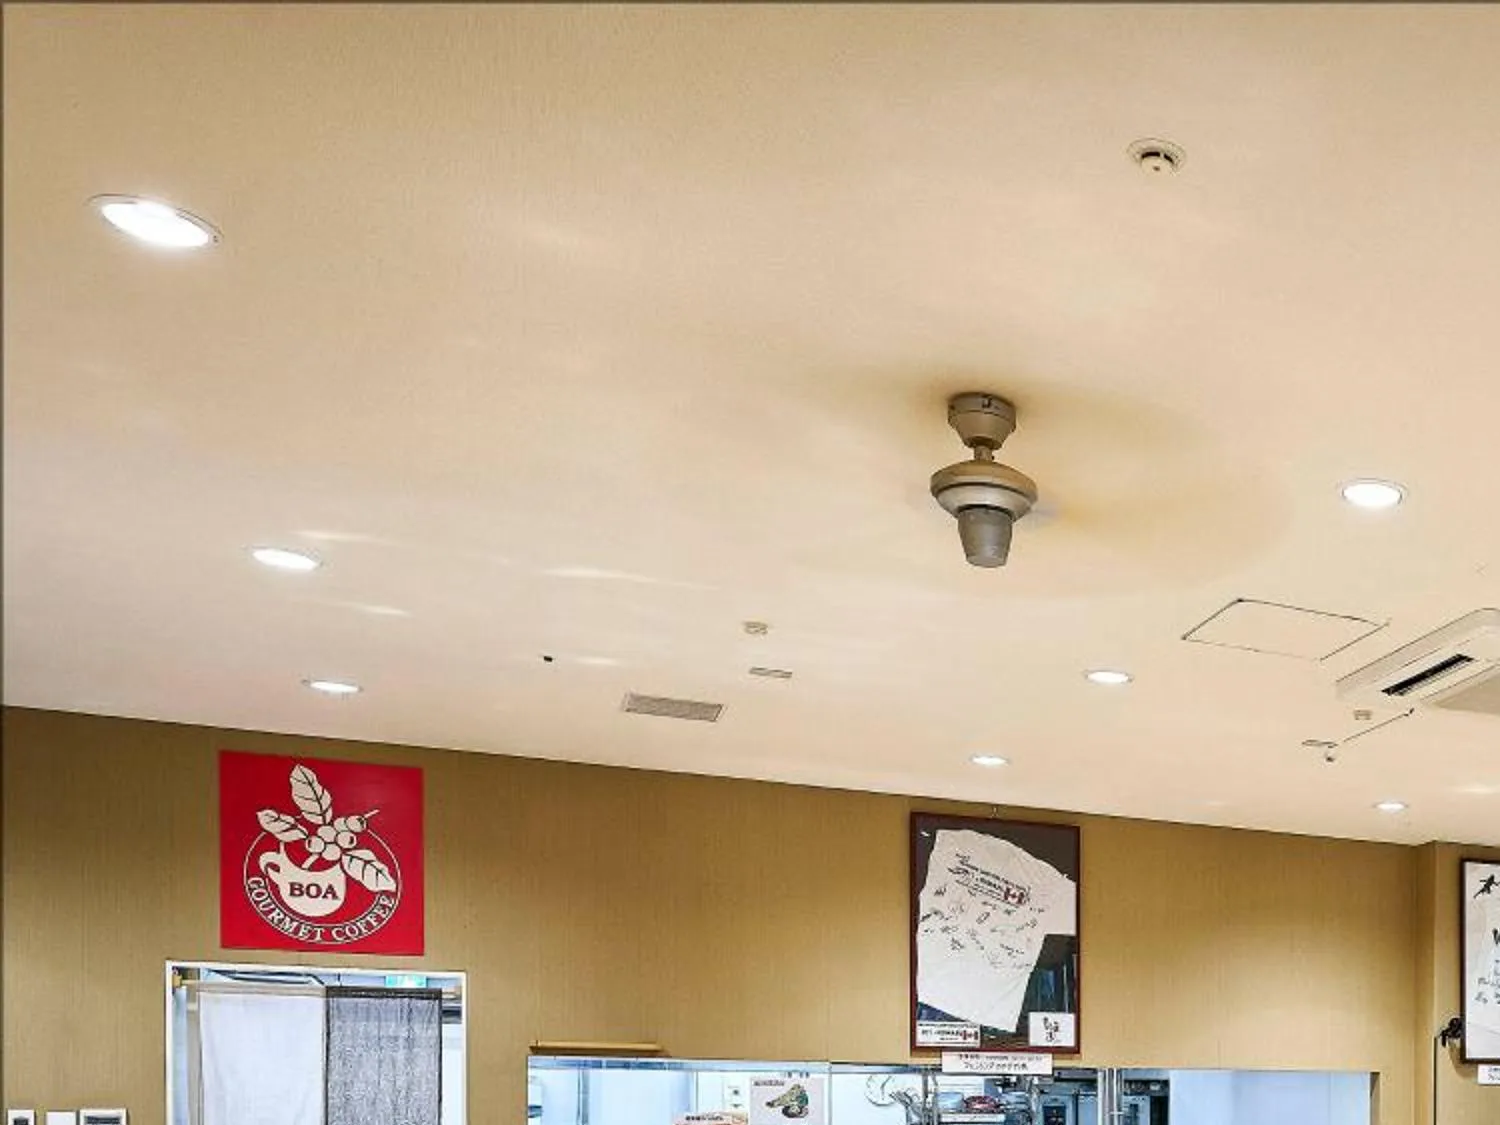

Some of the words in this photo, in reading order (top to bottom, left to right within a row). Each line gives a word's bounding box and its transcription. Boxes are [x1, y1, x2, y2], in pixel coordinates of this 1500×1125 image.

[250, 877, 325, 942] GOURMET
[331, 892, 395, 941] COFFEE
[288, 882, 339, 899] BOA
